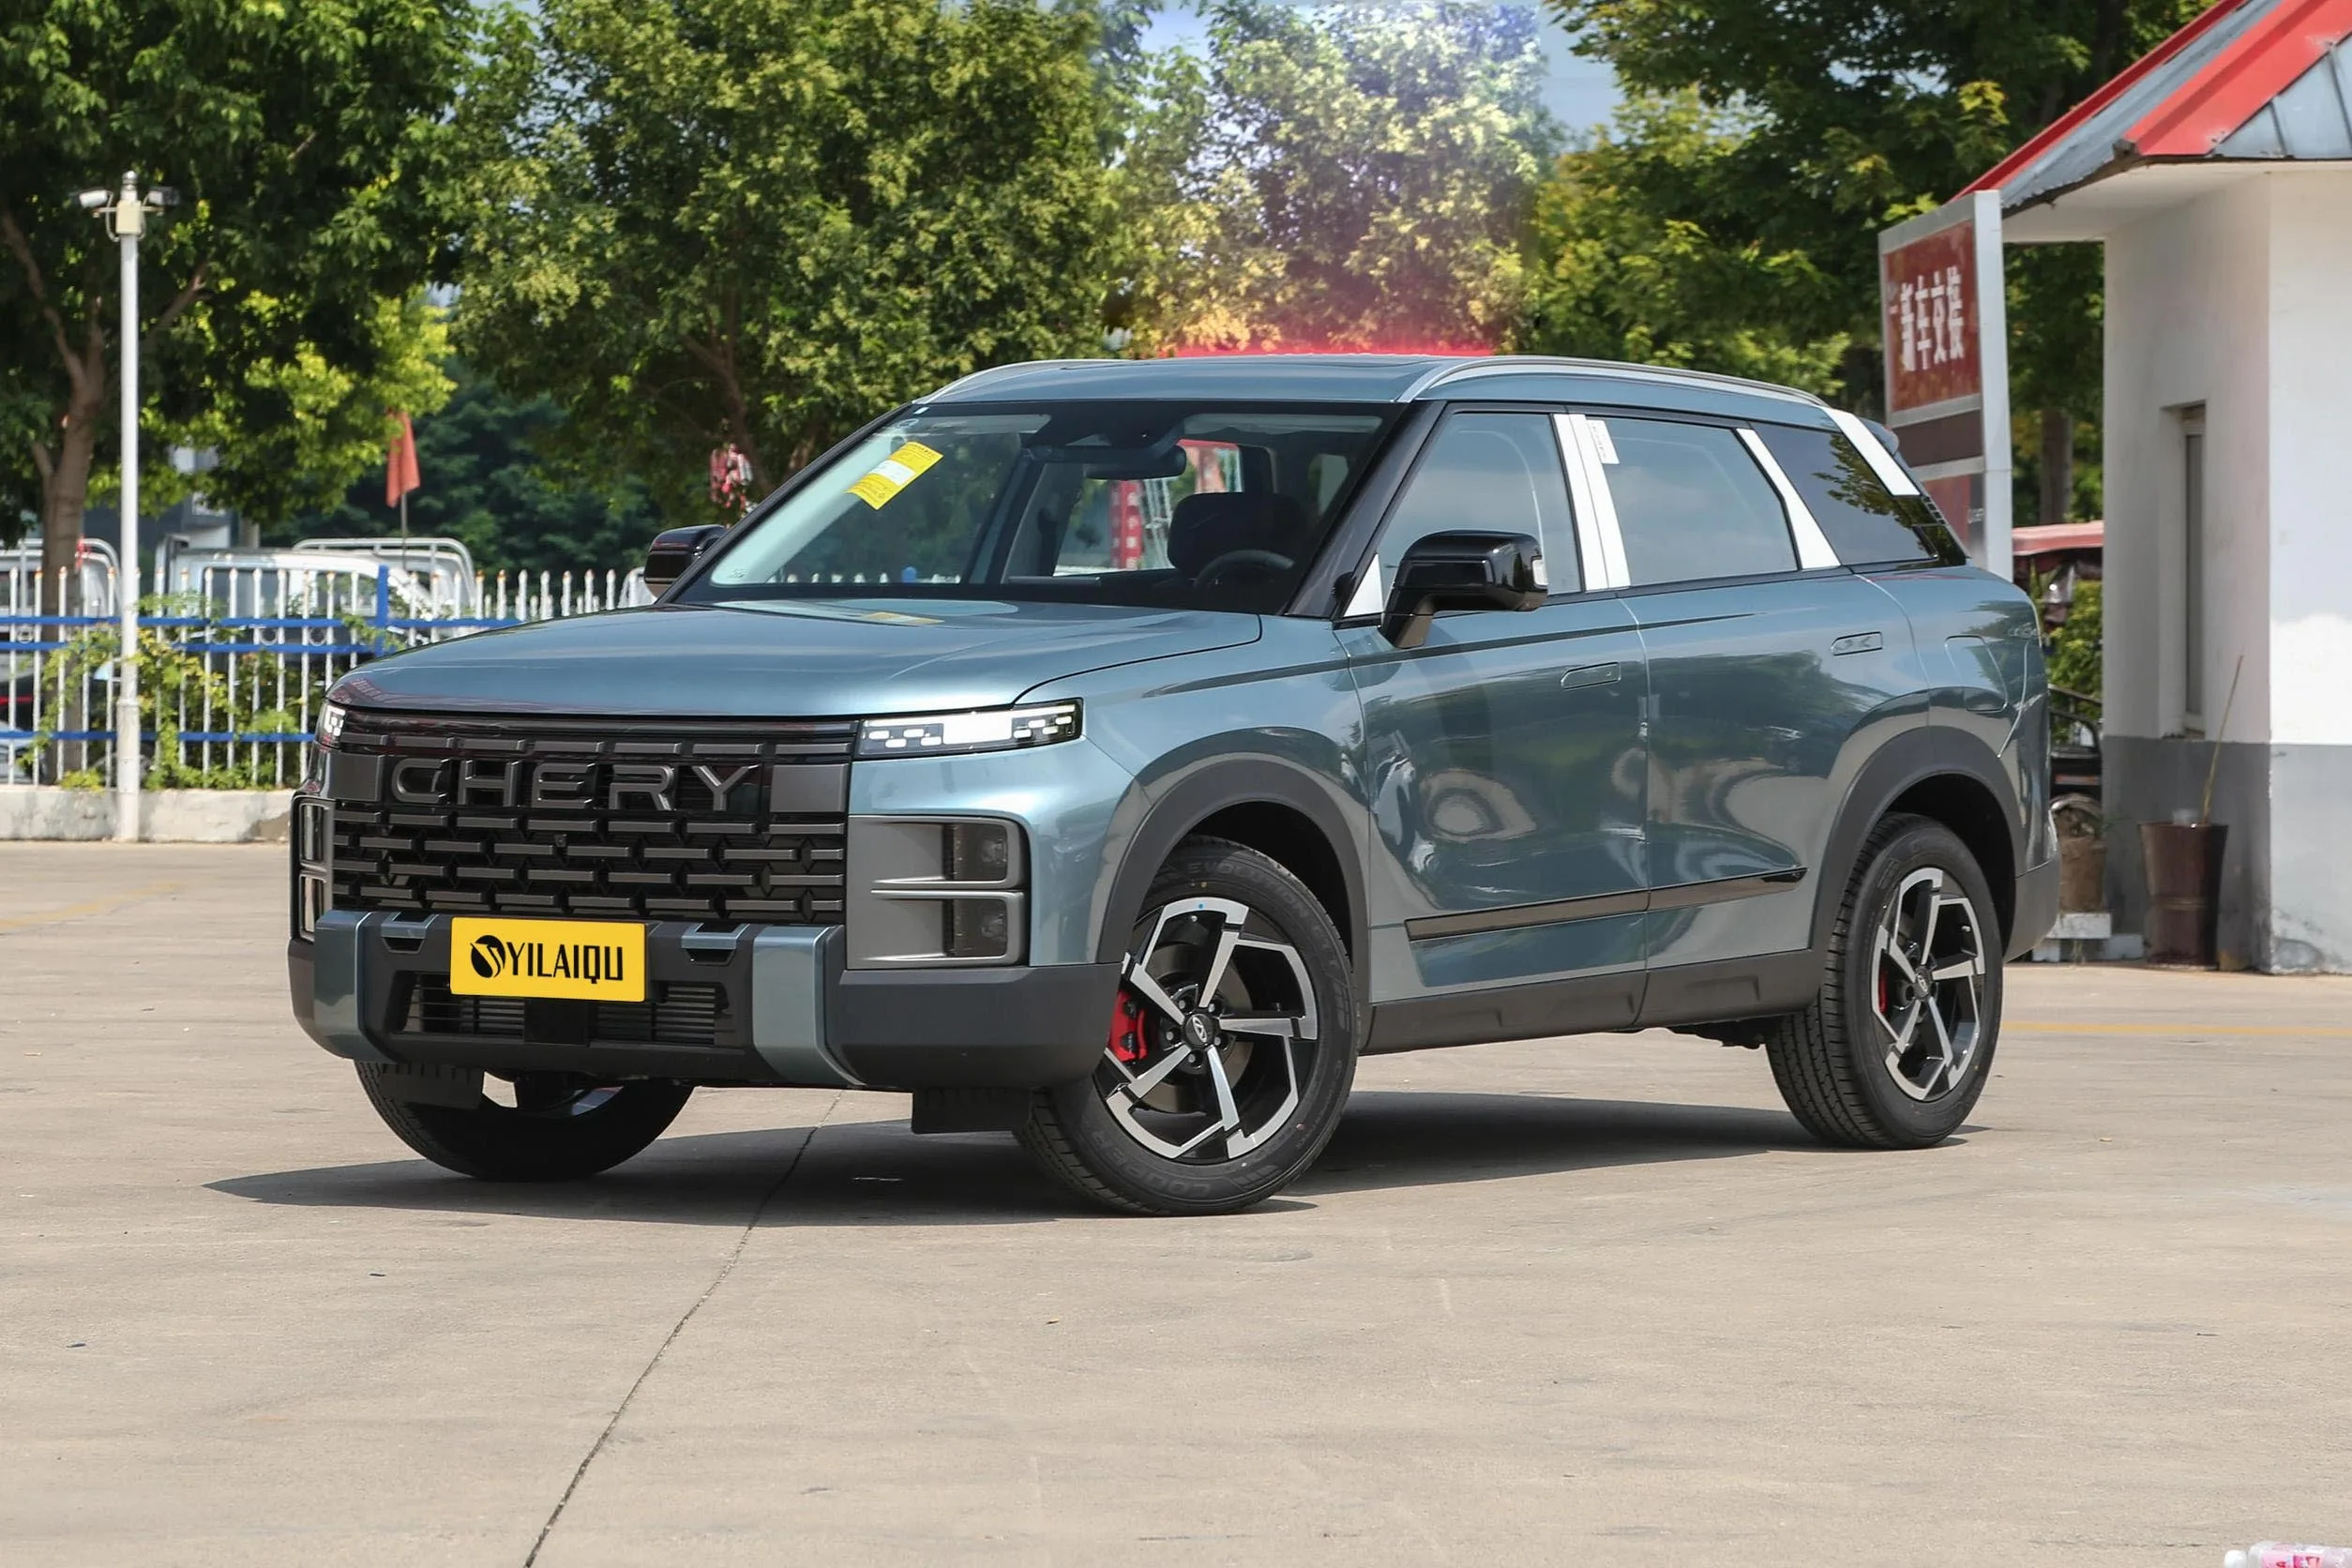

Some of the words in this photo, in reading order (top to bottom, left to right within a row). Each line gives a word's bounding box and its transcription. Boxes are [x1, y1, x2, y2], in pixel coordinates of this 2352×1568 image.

[390, 757, 761, 812] CHERY
[505, 941, 625, 985] YILAIQU
[1091, 1129, 1212, 1198] COOPER
